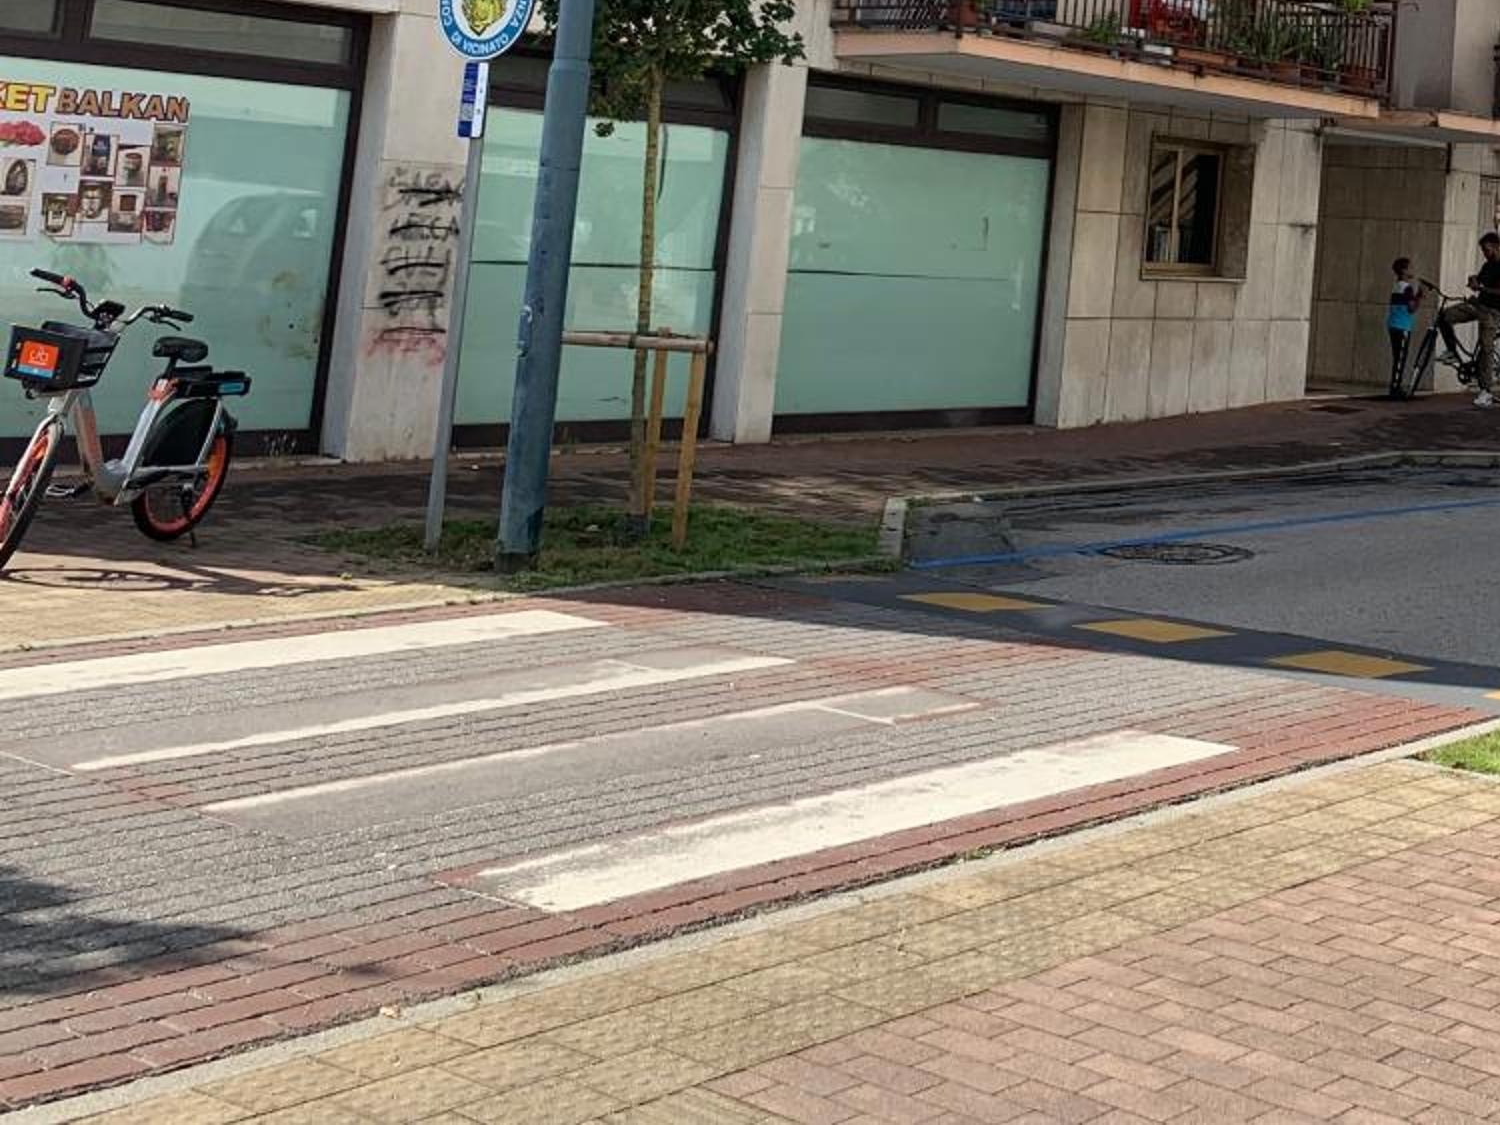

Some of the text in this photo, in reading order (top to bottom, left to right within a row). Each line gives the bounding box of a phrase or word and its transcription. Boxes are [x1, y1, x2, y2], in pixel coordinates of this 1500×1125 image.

[462, 34, 509, 54] VICINATO
[0, 80, 190, 123] ET BALKAN
